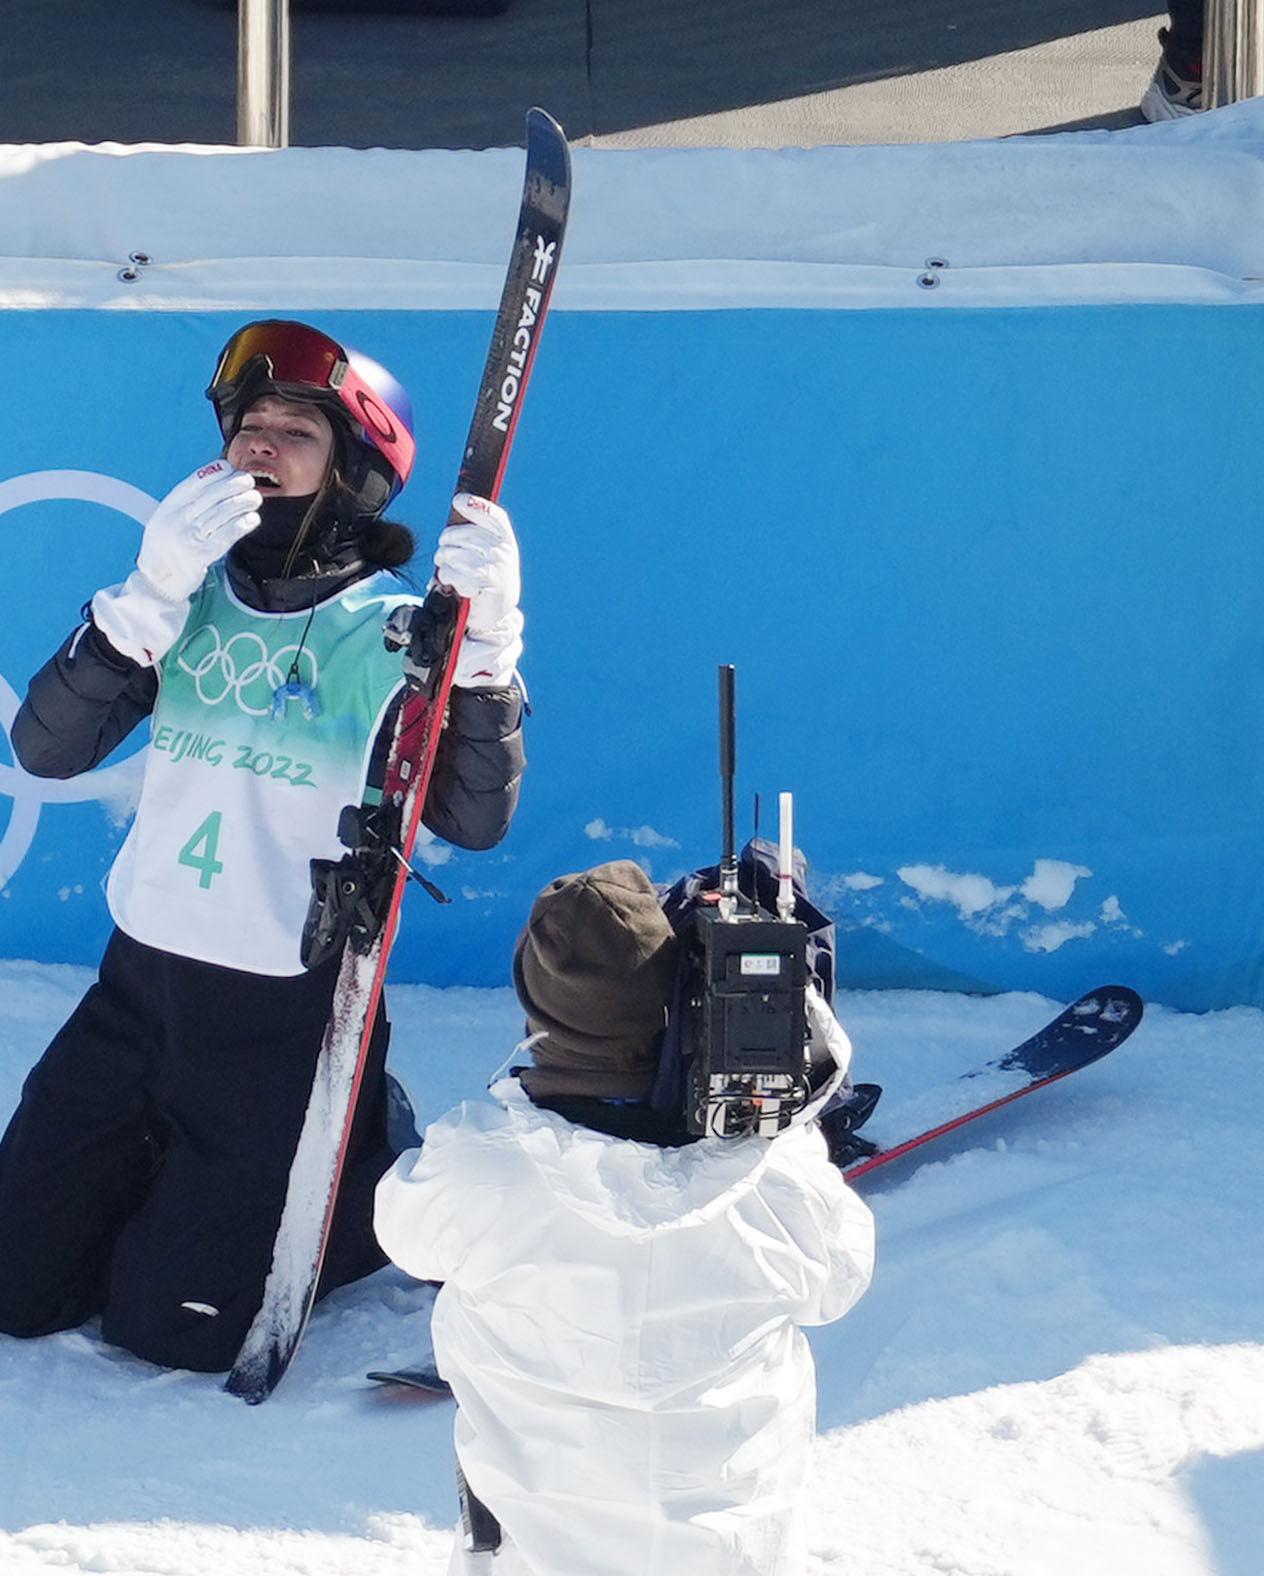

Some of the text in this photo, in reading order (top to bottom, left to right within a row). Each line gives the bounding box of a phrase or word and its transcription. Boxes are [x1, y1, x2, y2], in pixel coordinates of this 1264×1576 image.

[492, 286, 543, 433] FACTION
[153, 726, 319, 789] EIJING 2022
[178, 810, 223, 890] 4
